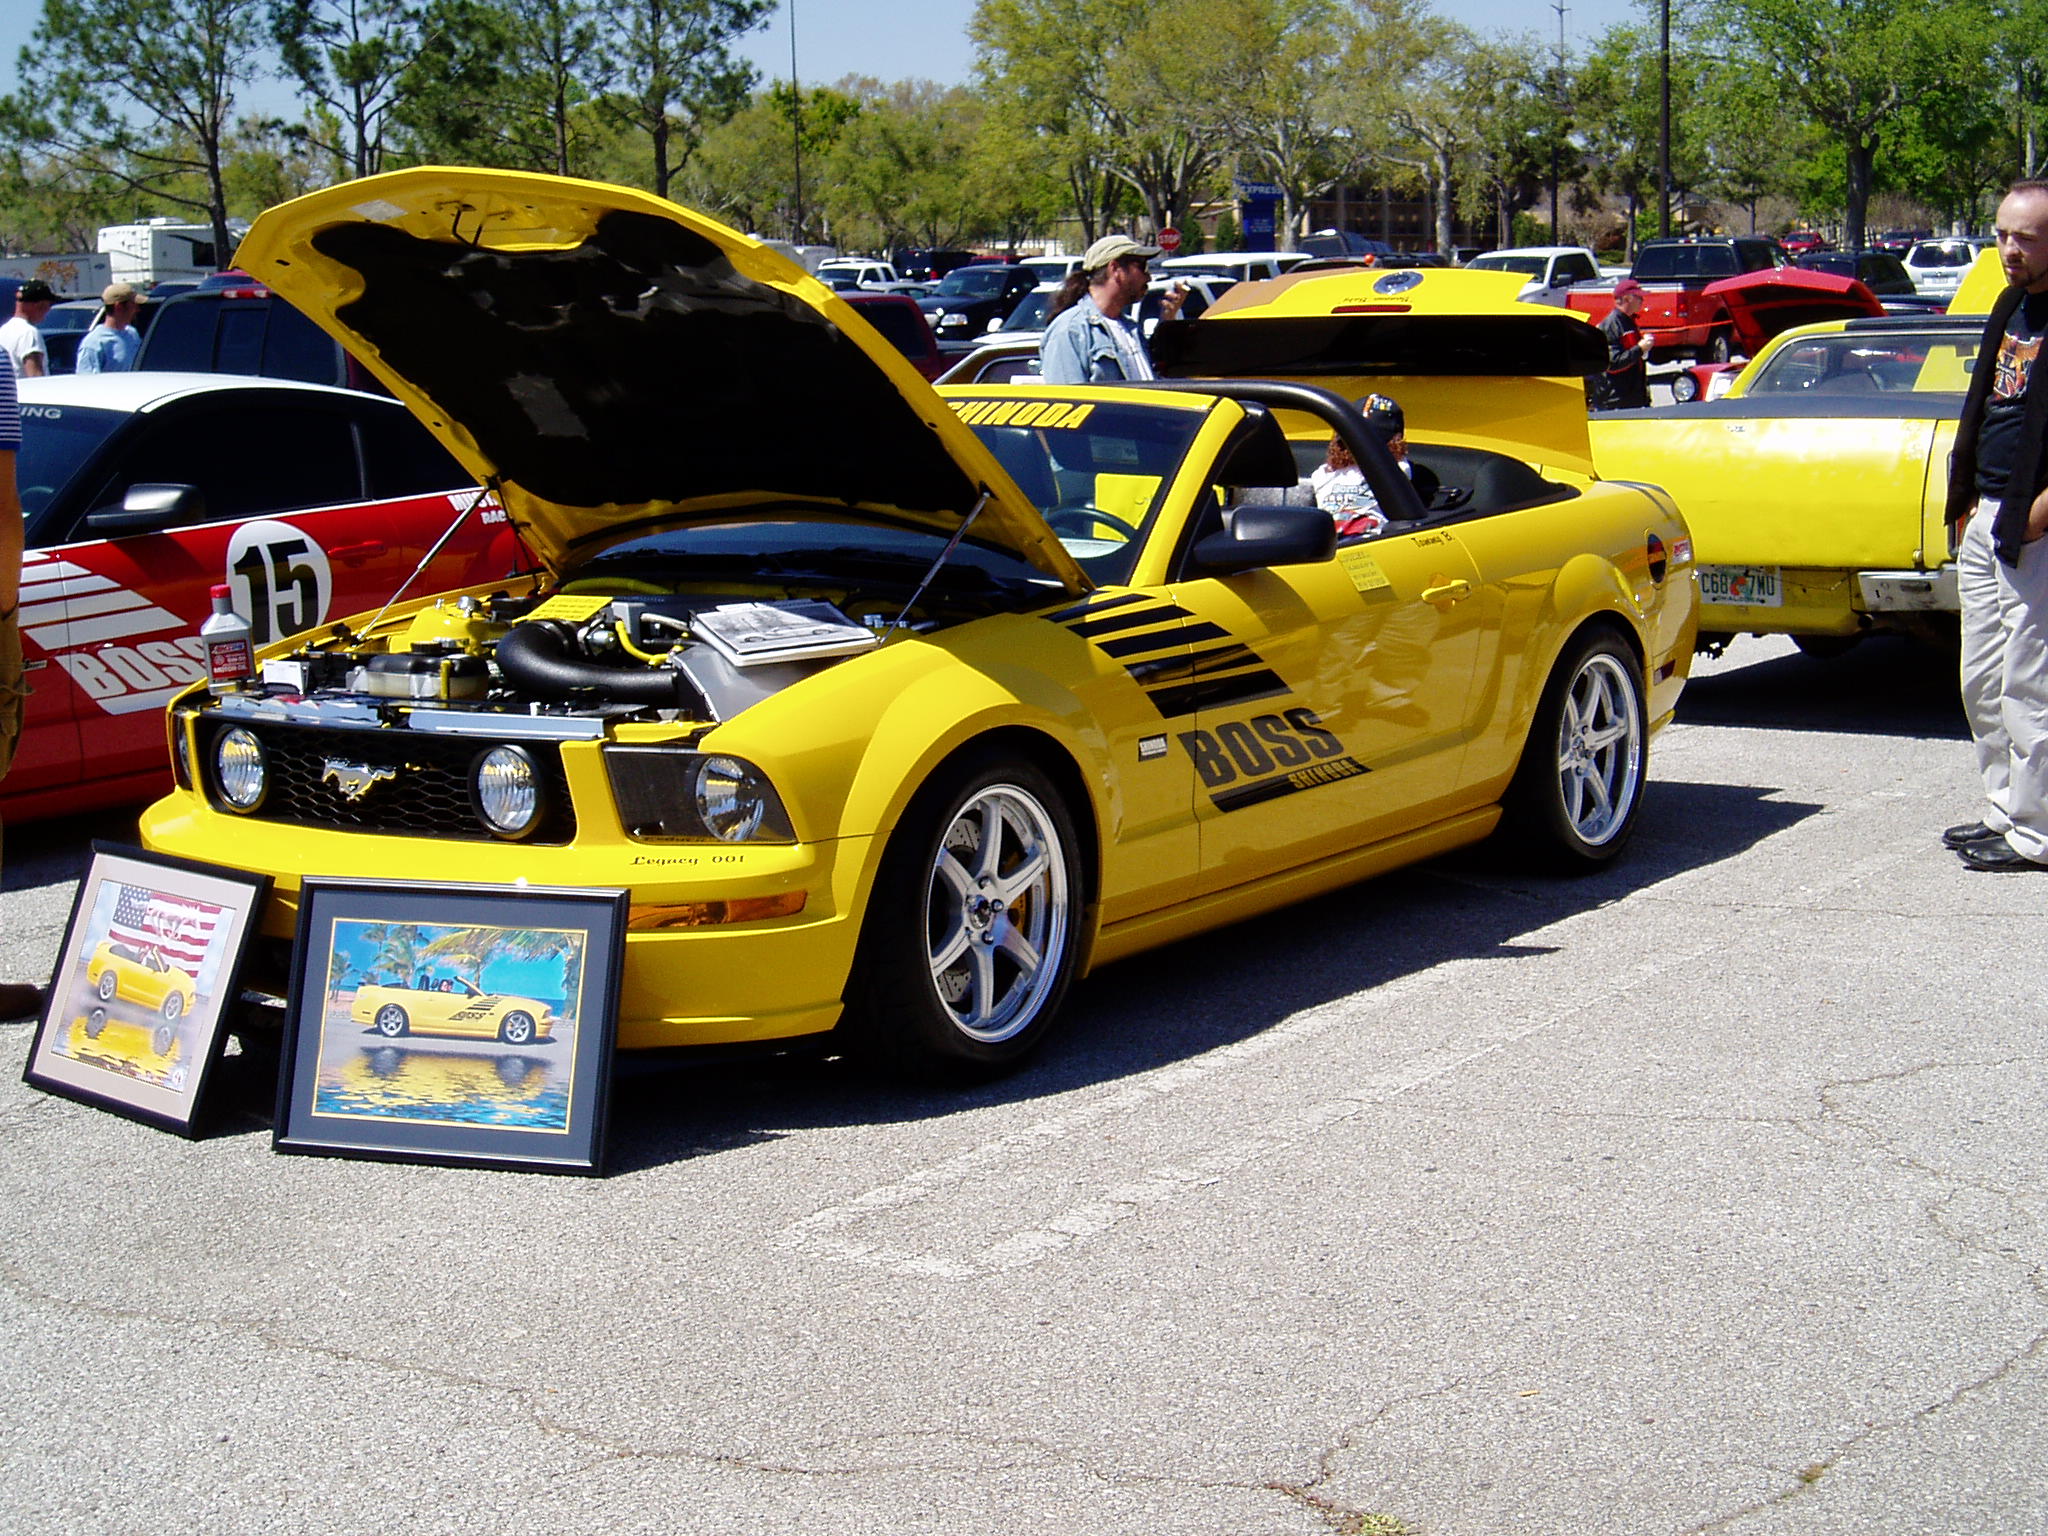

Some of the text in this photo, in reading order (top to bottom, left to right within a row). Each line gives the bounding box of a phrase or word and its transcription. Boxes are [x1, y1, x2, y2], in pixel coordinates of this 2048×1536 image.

[1158, 234, 1181, 244] STOP
[233, 538, 319, 644] 15
[1177, 707, 1345, 788] BOSS
[1288, 759, 1362, 789] SHINODA
[629, 856, 699, 865] Legacy
